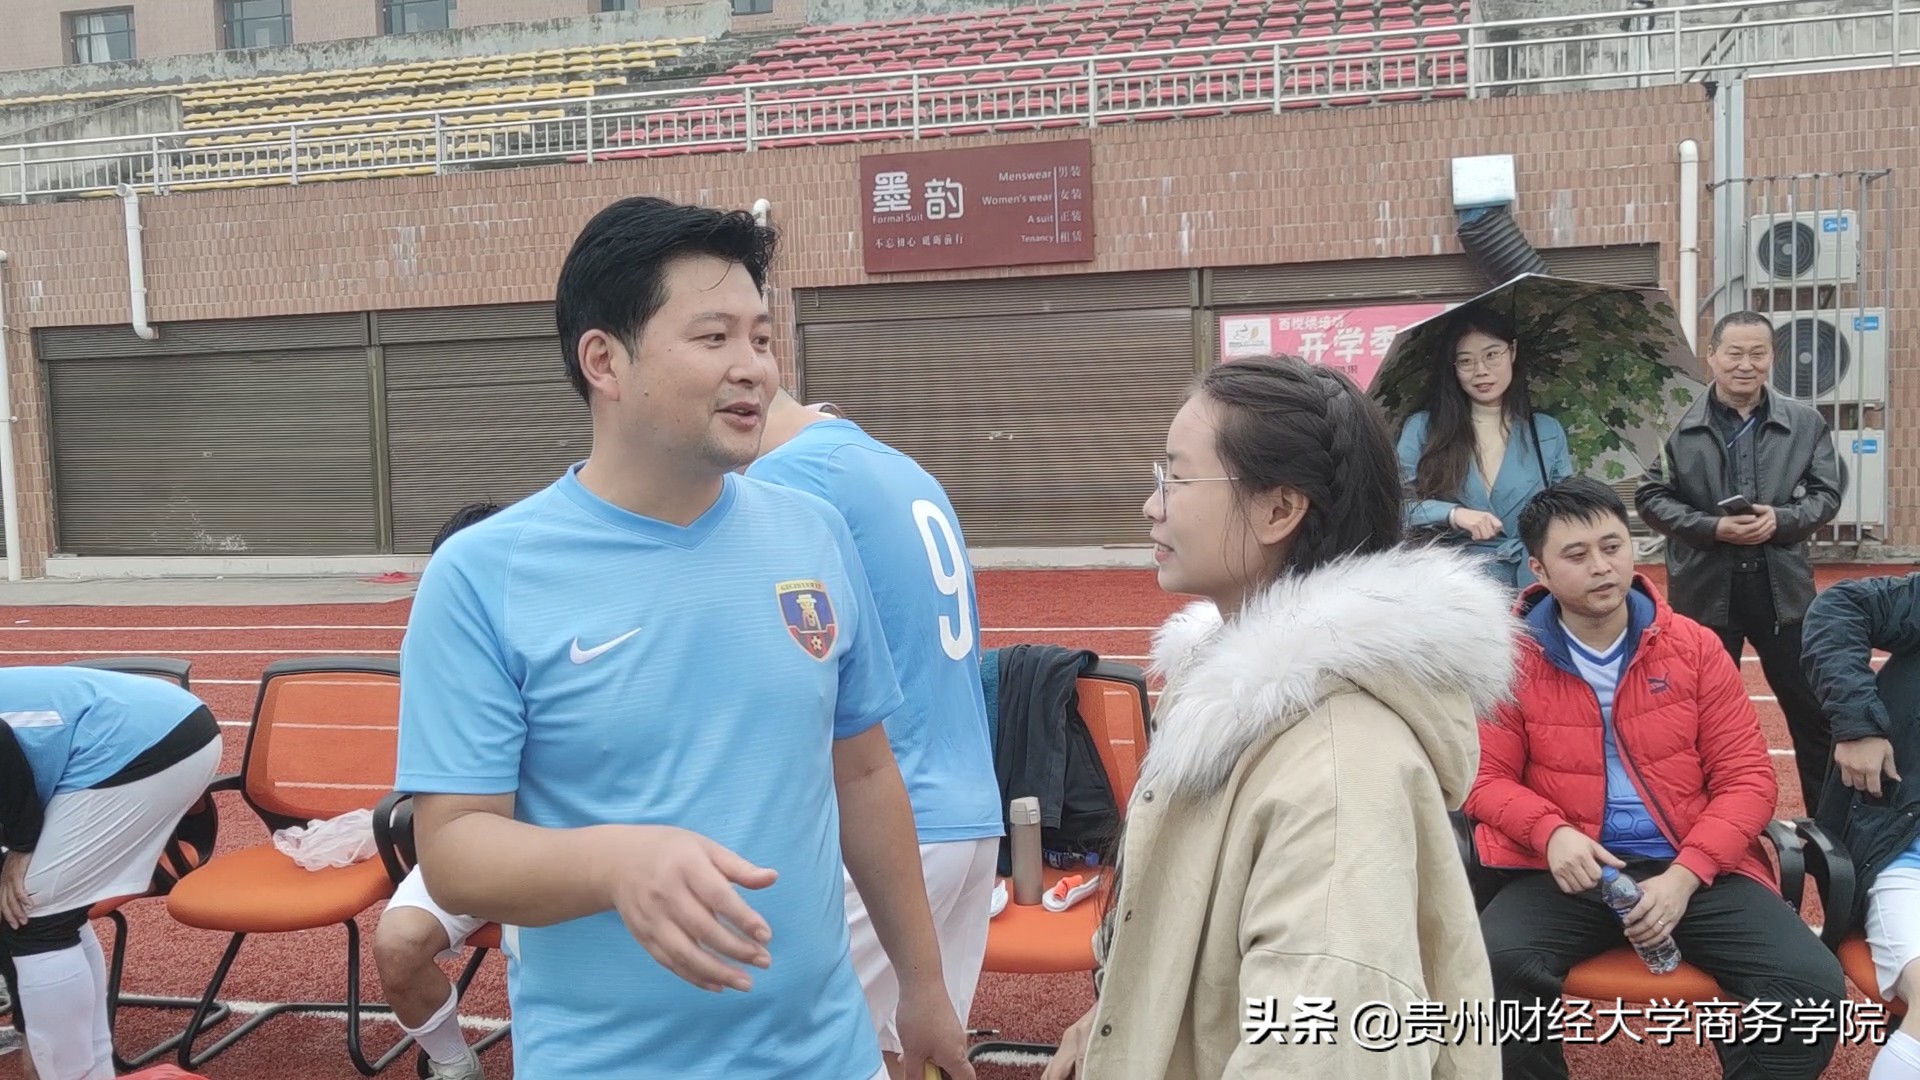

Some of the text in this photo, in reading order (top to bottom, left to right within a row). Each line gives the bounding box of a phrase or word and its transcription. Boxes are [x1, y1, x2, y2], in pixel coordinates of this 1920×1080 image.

[998, 170, 1052, 182] Menswear
[1058, 165, 1081, 178] 男装
[873, 171, 965, 220] 墨韵
[981, 192, 1053, 206] Women's wear
[1060, 187, 1082, 201] 女装
[872, 211, 924, 225] Formal Suit
[1026, 213, 1054, 224] A suit
[1060, 210, 1082, 222] 正装
[875, 236, 917, 250] 不忘初心
[1021, 234, 1055, 244] Tenancy
[1060, 230, 1082, 243] 租赁
[1298, 324, 1398, 364] 开学季
[911, 499, 974, 661] 9
